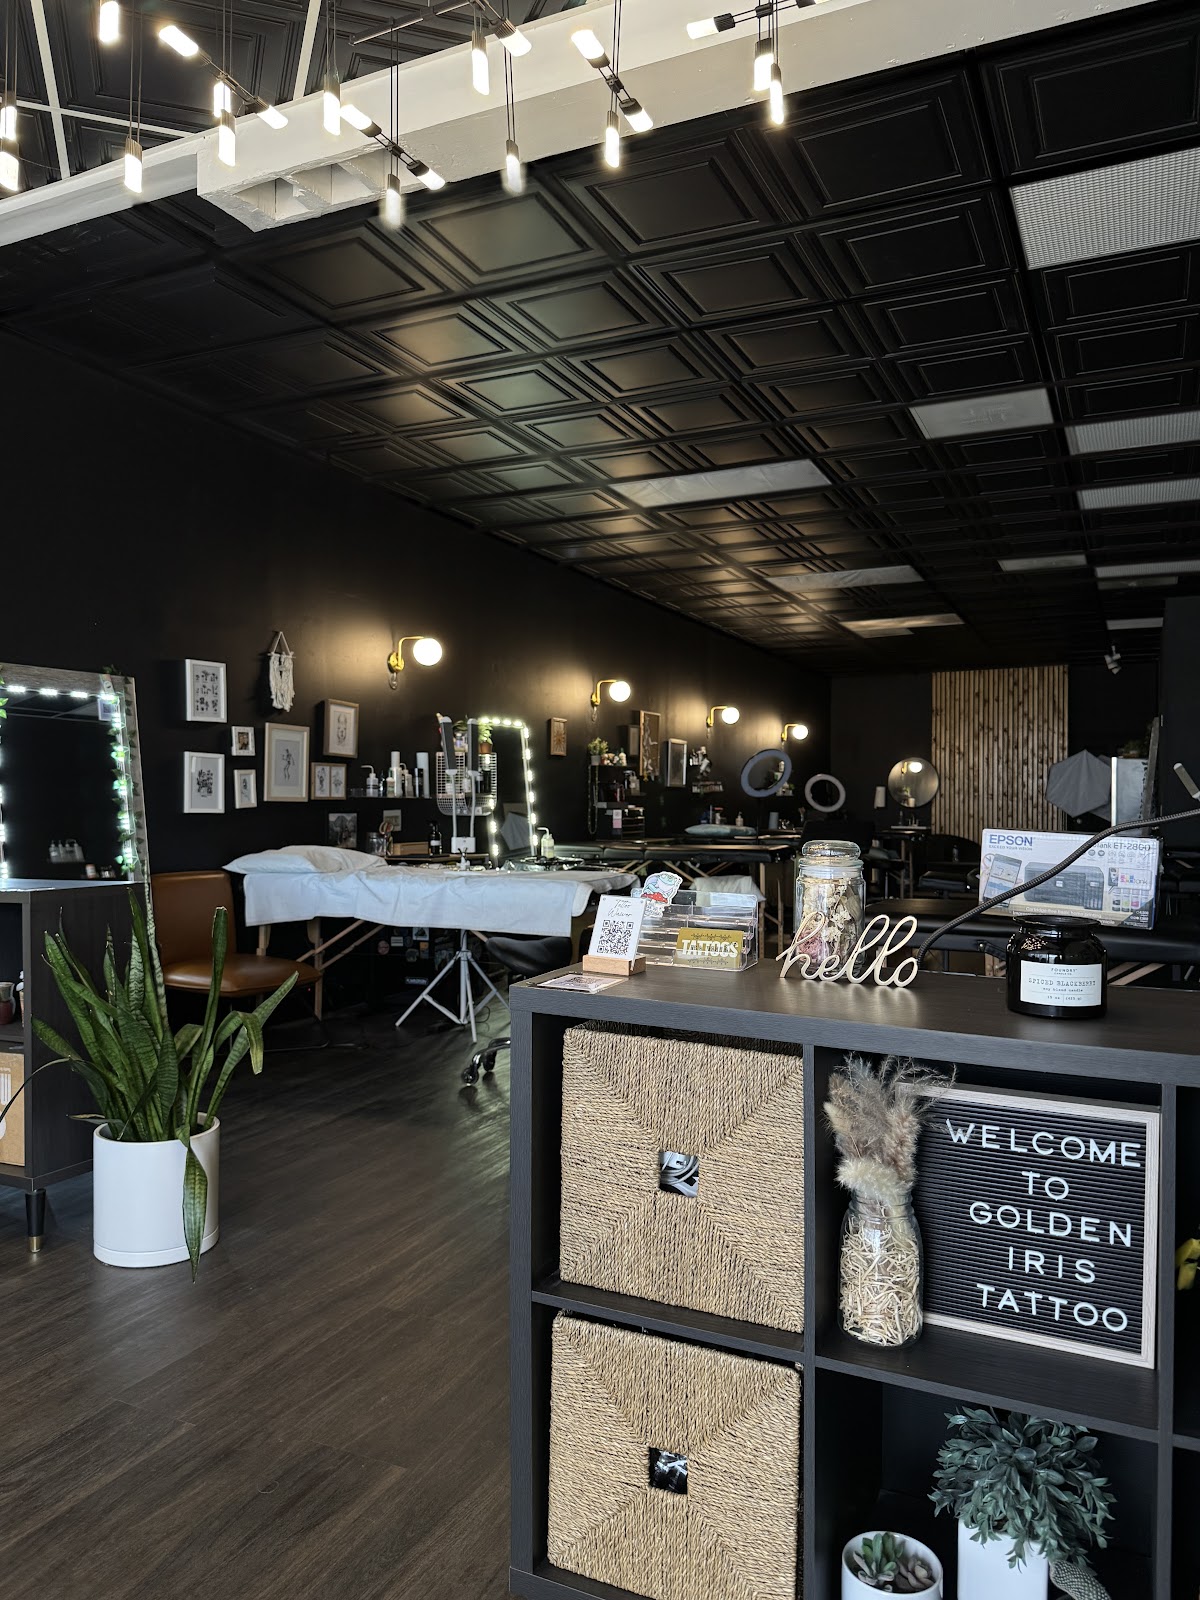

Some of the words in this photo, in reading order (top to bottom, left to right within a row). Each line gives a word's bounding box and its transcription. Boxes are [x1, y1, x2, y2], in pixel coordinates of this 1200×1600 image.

[989, 834, 1033, 847] EPSON
[681, 939, 739, 958] TATTOOS
[776, 910, 919, 988] hello
[1028, 978, 1054, 986] SPICED
[945, 1118, 1141, 1168] WELCOME
[1021, 1170, 1070, 1201] TO
[969, 1201, 1132, 1248] GOLDEN
[1008, 1246, 1096, 1284] IRIS
[976, 1283, 1128, 1333] TATTOO
